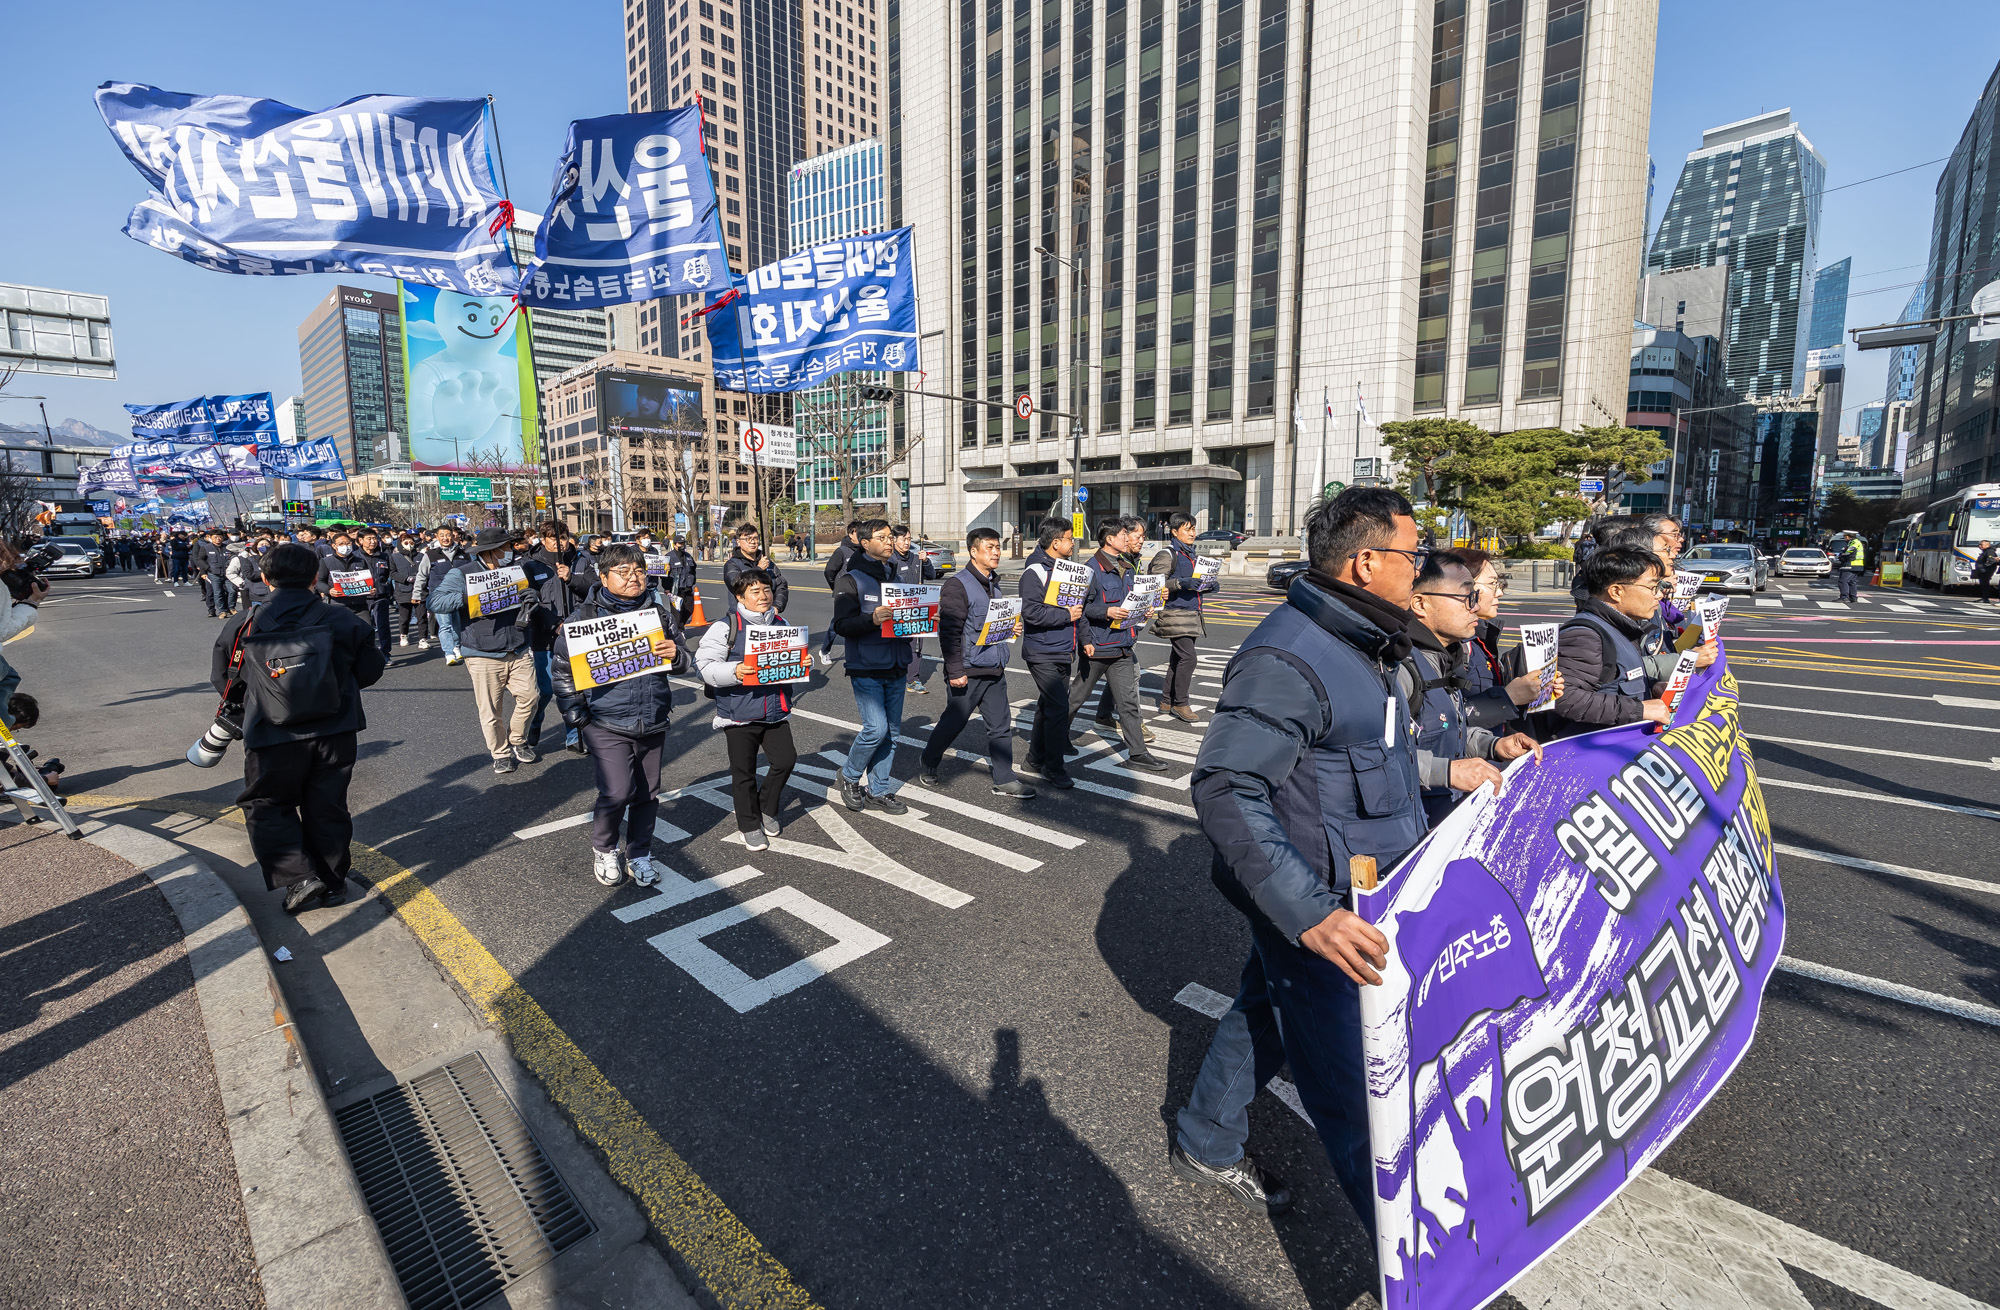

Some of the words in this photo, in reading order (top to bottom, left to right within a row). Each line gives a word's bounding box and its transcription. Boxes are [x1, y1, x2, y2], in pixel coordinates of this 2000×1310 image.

[344, 295, 372, 304] KYOBO
[771, 430, 794, 438] 청계천로
[1056, 560, 1086, 575] 진짜사장
[469, 571, 499, 584] 진짜사장
[486, 575, 513, 590] 나와라!
[1678, 575, 1700, 586] 짜사장
[479, 584, 518, 604] 원청교섭
[884, 587, 902, 597] 모든
[902, 586, 927, 597] 노동자의
[1059, 582, 1088, 597] 원청교
[887, 597, 919, 608] 노동기본권
[990, 600, 1010, 611] 진짜사장
[892, 606, 929, 622] 투쟁으로
[568, 618, 618, 639] 진짜사장
[893, 619, 934, 636] 쟁취하자!
[989, 618, 1016, 633] 원청교섭
[595, 623, 640, 647] 나와라!
[749, 630, 768, 641] 모든
[768, 628, 799, 640] 노동자의
[1525, 627, 1554, 647] 진짜사장
[586, 637, 651, 668] 원청교섭
[751, 640, 789, 653] 노동기본권
[757, 649, 801, 668] 투쟁으로
[591, 652, 663, 684] 쟁취하자!
[757, 664, 806, 684] 쟁취하자!
[1556, 794, 1659, 912] 3월
[1609, 743, 1707, 852] 10일
[1437, 913, 1512, 984] 민주노총
[1507, 884, 1742, 1217] 원청교섭
[1701, 803, 1770, 964] 쟁취!
